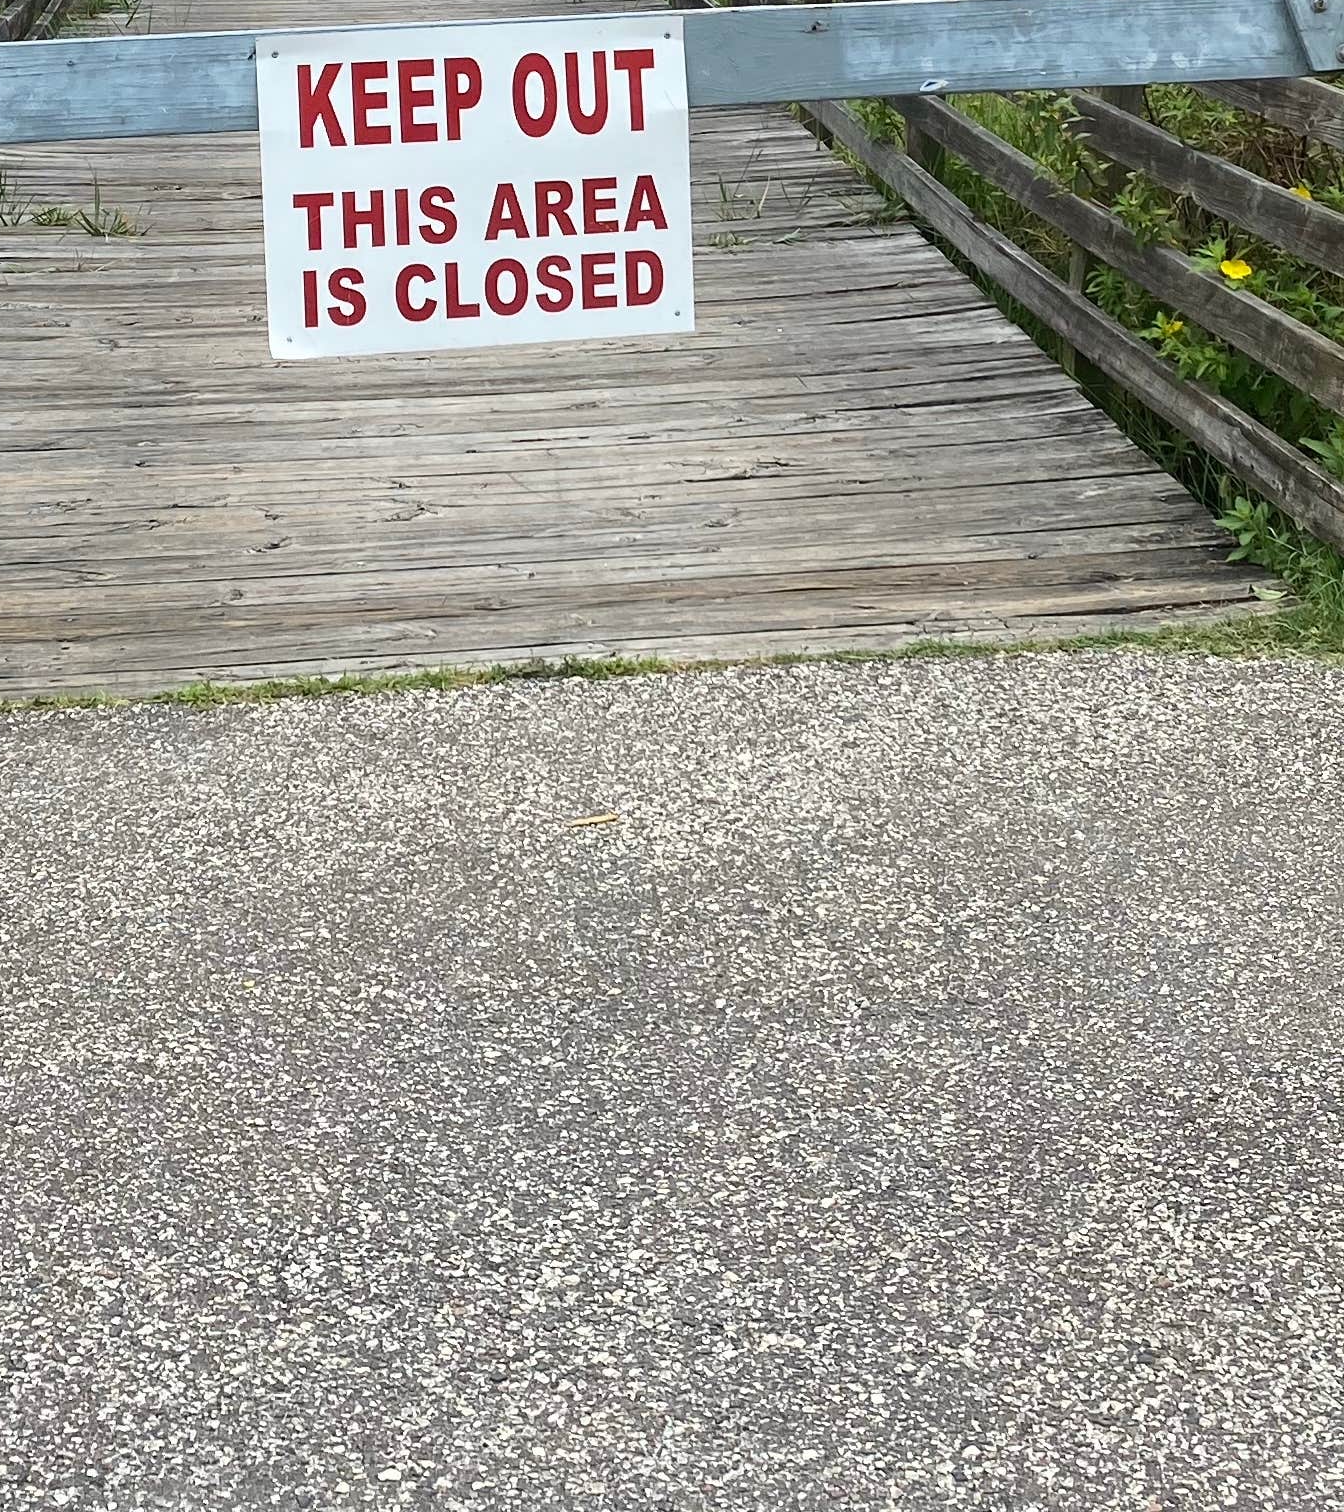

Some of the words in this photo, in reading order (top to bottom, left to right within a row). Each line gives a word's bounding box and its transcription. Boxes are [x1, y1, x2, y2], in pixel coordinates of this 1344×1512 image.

[297, 56, 482, 149] KEEP
[512, 48, 655, 138] OUT
[293, 185, 458, 251] THIS
[484, 174, 669, 241] AREA
[302, 267, 367, 328] IS
[395, 249, 665, 322] CLOSED
